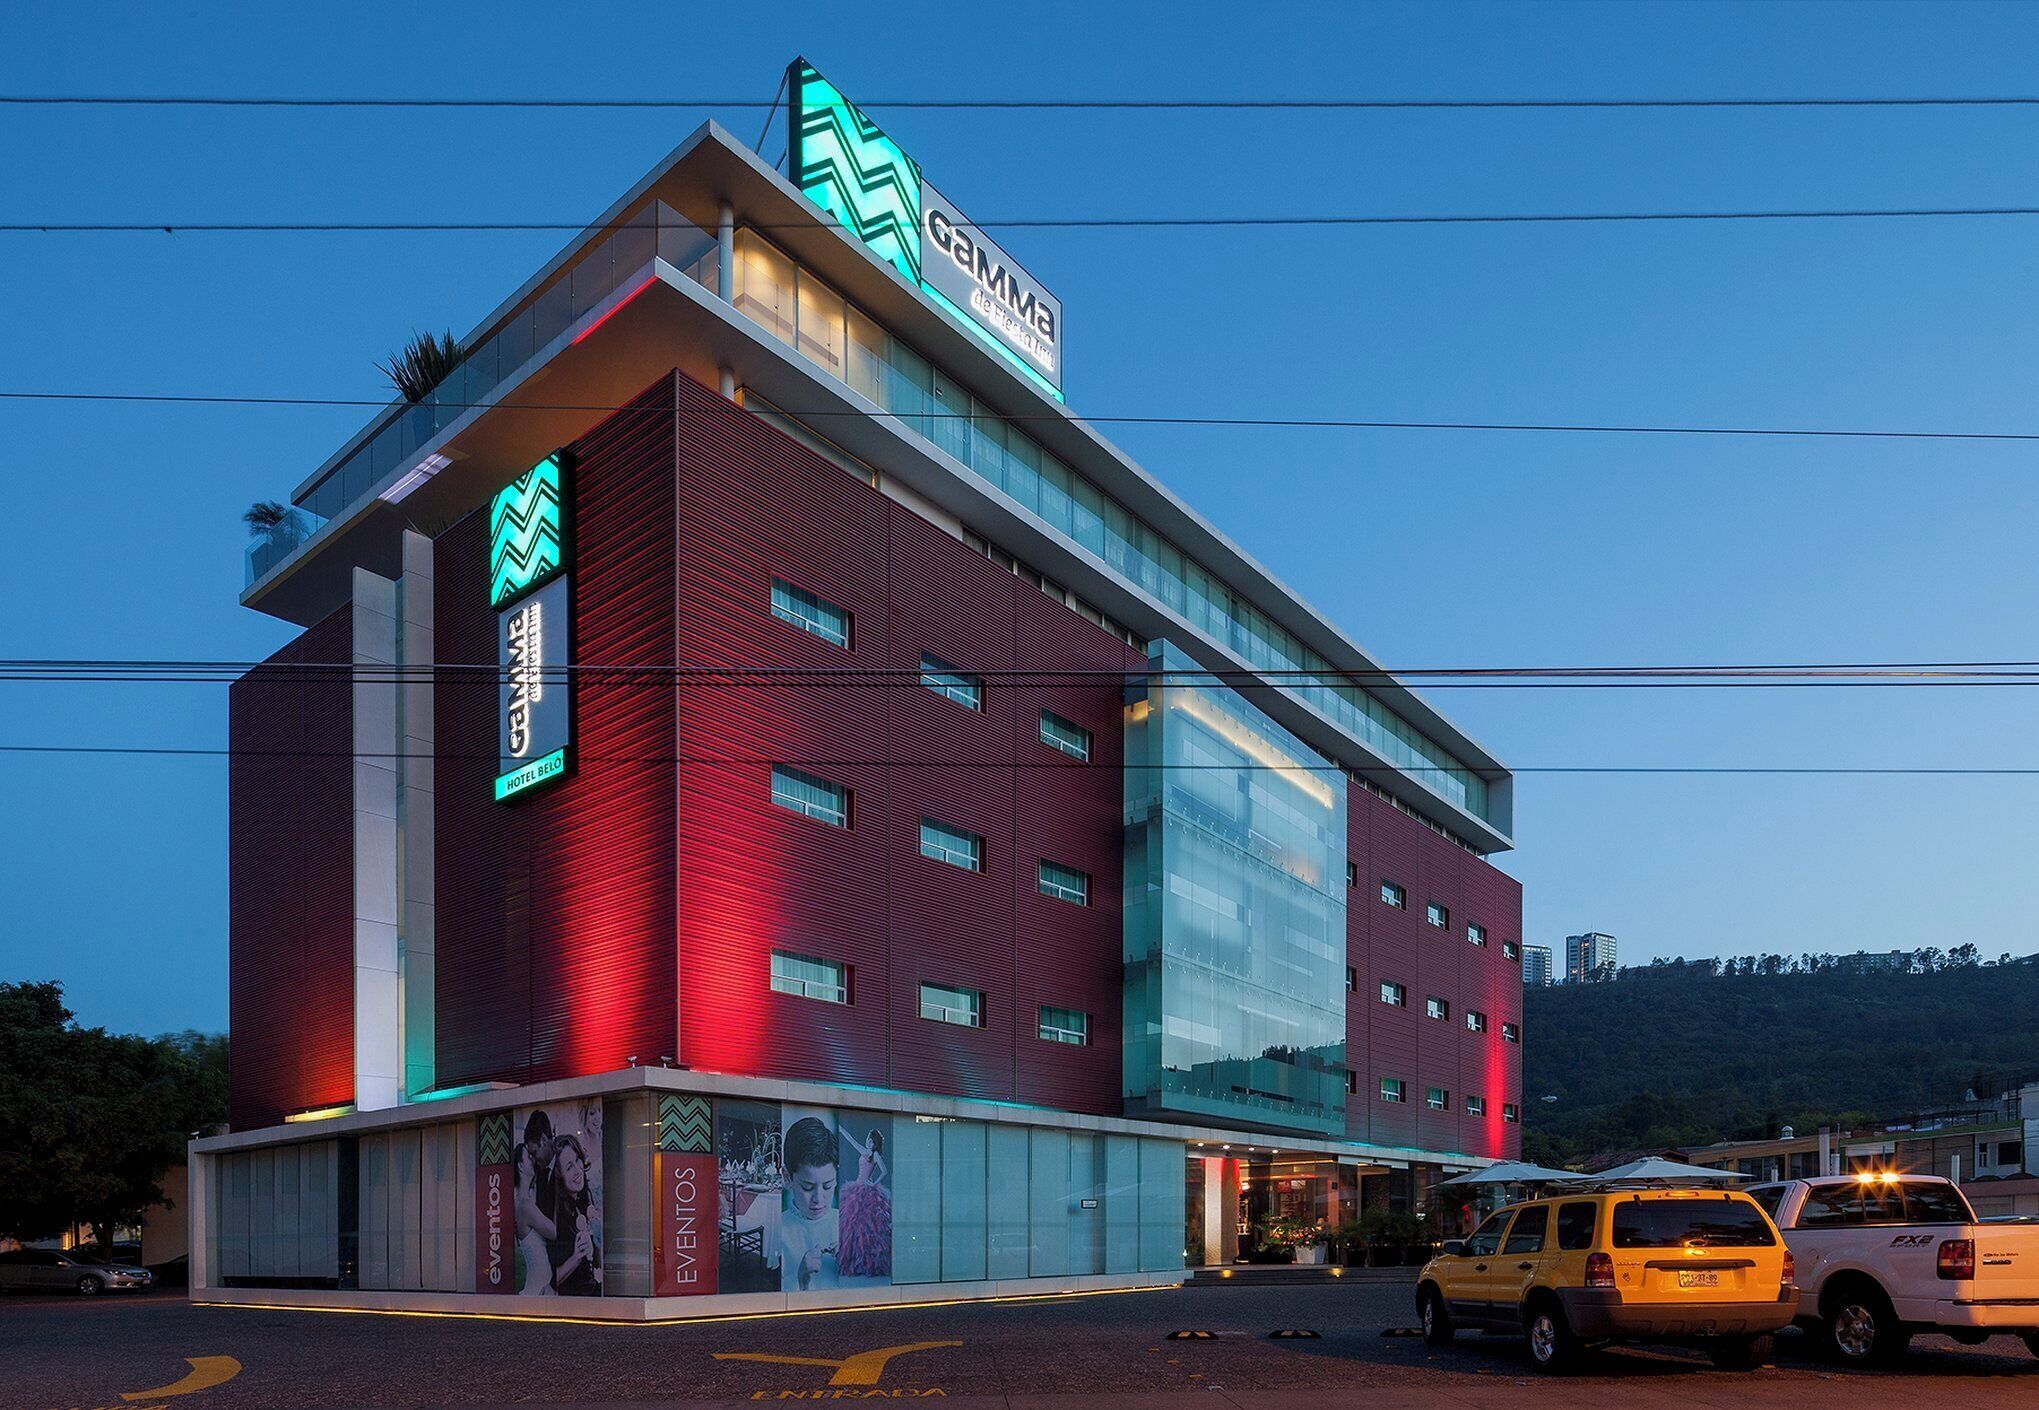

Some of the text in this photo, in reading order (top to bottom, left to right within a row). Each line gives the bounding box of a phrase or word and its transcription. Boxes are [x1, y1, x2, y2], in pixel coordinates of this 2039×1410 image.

[974, 289, 991, 313] de
[507, 769, 536, 791] HOTEL
[487, 1173, 502, 1285] eventos
[675, 1166, 697, 1284] EVENTOS
[1891, 1235, 1935, 1244] FX2
